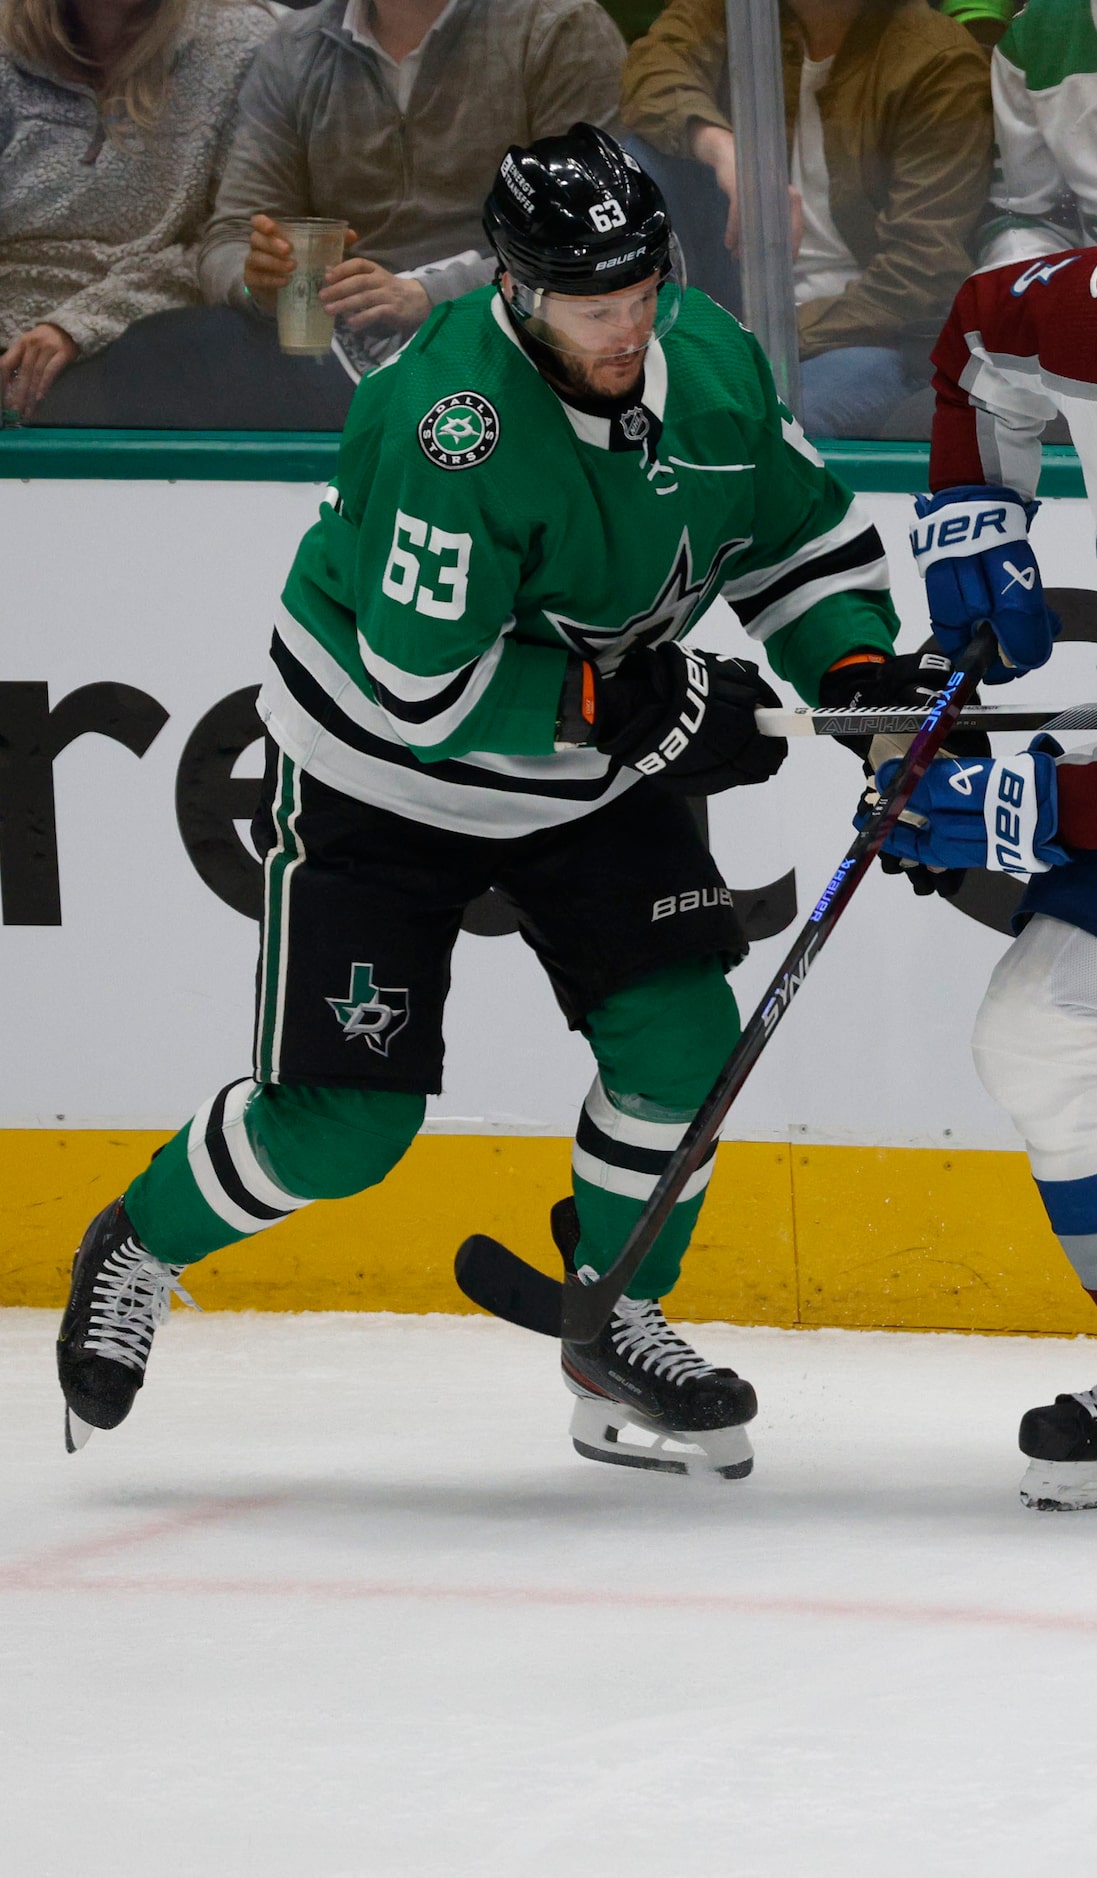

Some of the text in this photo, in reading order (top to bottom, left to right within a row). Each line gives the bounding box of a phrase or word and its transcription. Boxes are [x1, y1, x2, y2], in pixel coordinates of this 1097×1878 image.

[505, 174, 535, 214] TRANSFER
[509, 165, 536, 196] ENERGY
[588, 199, 627, 233] 63
[436, 397, 495, 441] DALLAS
[422, 428, 478, 465] STARS
[910, 508, 1007, 557] UER
[382, 508, 473, 621] 63
[920, 671, 965, 732] SYNC
[819, 716, 922, 734] ALPHA
[995, 767, 1029, 875] BAU
[761, 932, 821, 1037] SYNC
